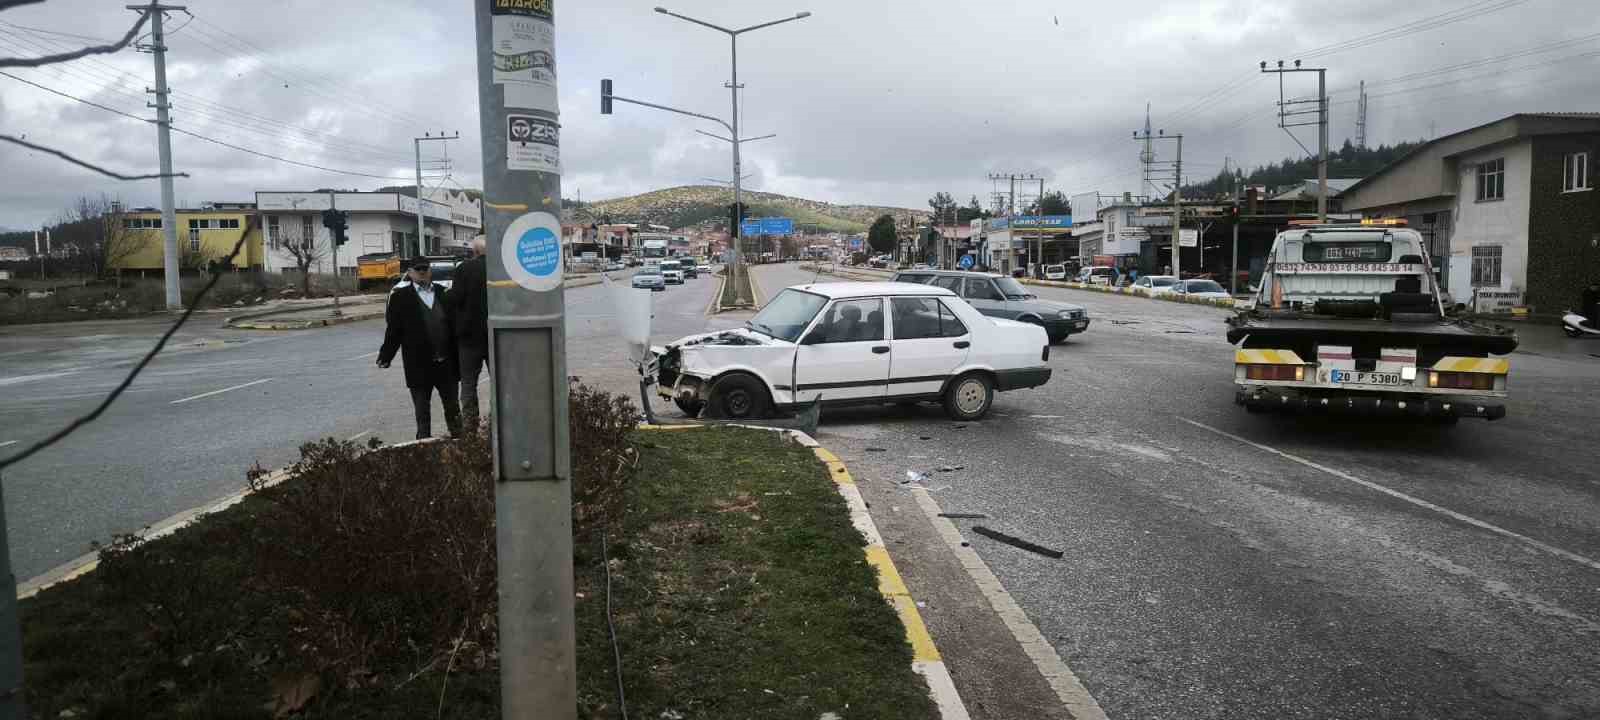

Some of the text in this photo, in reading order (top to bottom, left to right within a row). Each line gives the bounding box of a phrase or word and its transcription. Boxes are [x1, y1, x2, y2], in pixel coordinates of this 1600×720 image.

[1337, 372, 1398, 384] 20 P 5380
